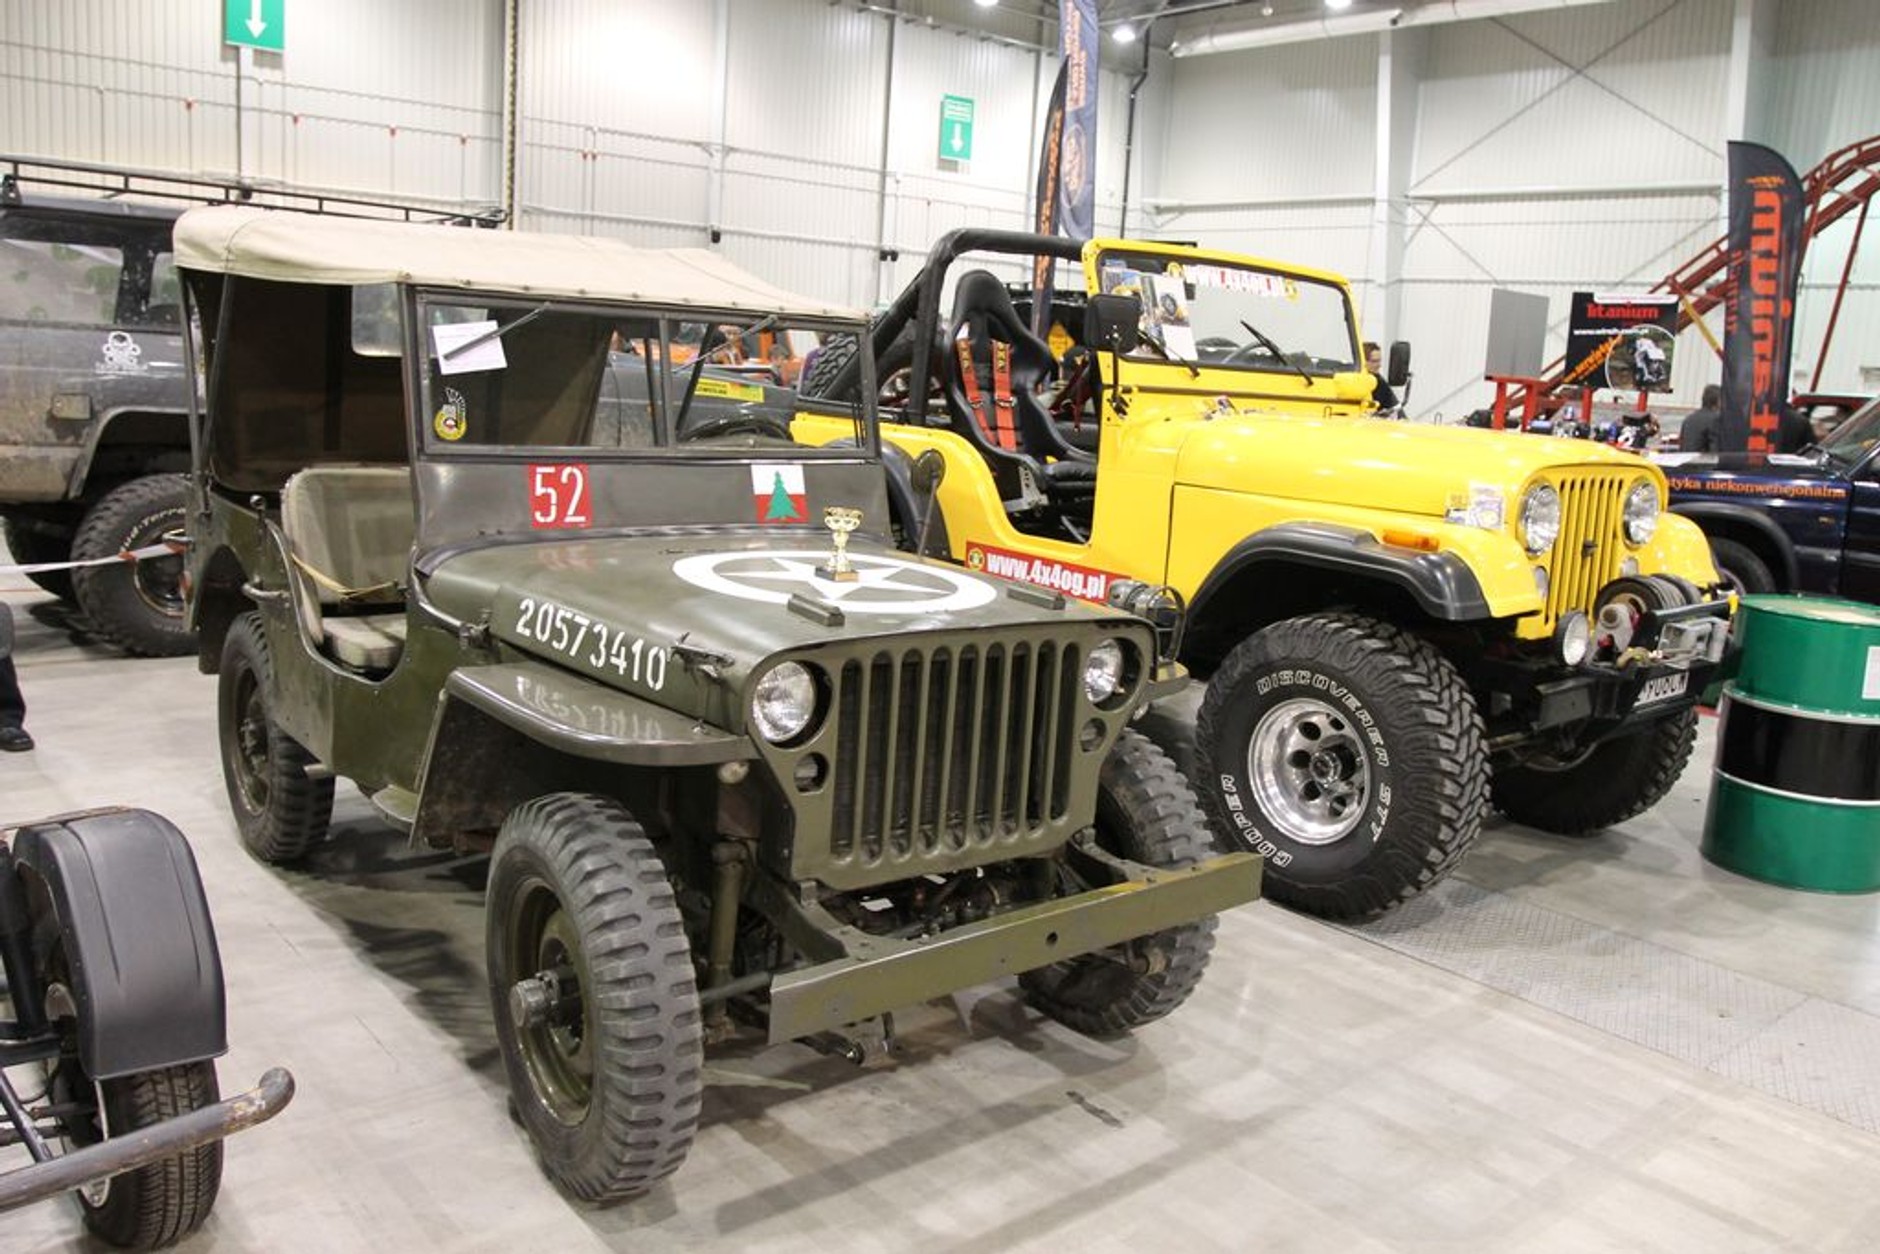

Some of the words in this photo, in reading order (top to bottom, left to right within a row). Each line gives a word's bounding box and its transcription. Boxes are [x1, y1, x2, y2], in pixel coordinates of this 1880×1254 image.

[534, 466, 586, 523] 52
[986, 552, 1107, 600] www.4x4og.pl
[515, 597, 667, 692] 20573410
[1255, 669, 1391, 767] DISCOVERER
[1370, 782, 1392, 843] STT
[1220, 774, 1294, 868] COOPER
